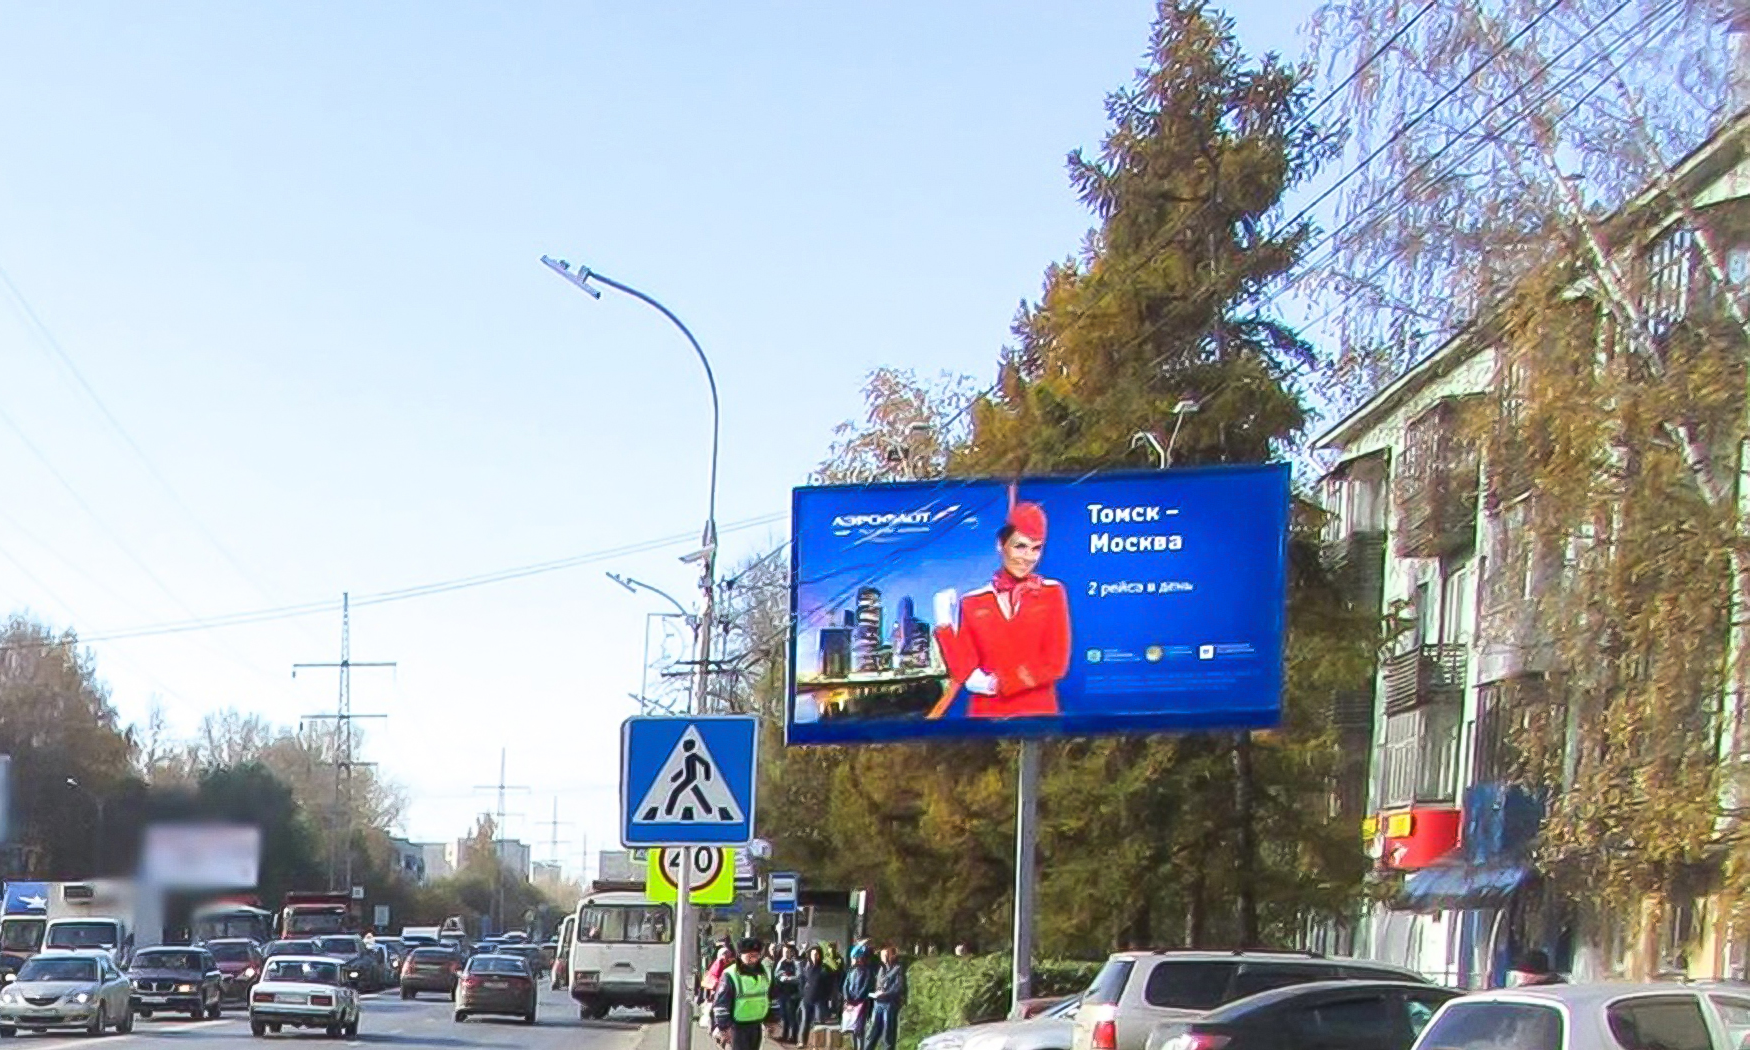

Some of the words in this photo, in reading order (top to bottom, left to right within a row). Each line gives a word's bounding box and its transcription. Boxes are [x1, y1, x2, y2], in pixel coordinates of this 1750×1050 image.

[1087, 504, 1160, 525] Томск
[1090, 532, 1183, 554] Москва
[1088, 581, 1098, 596] 2
